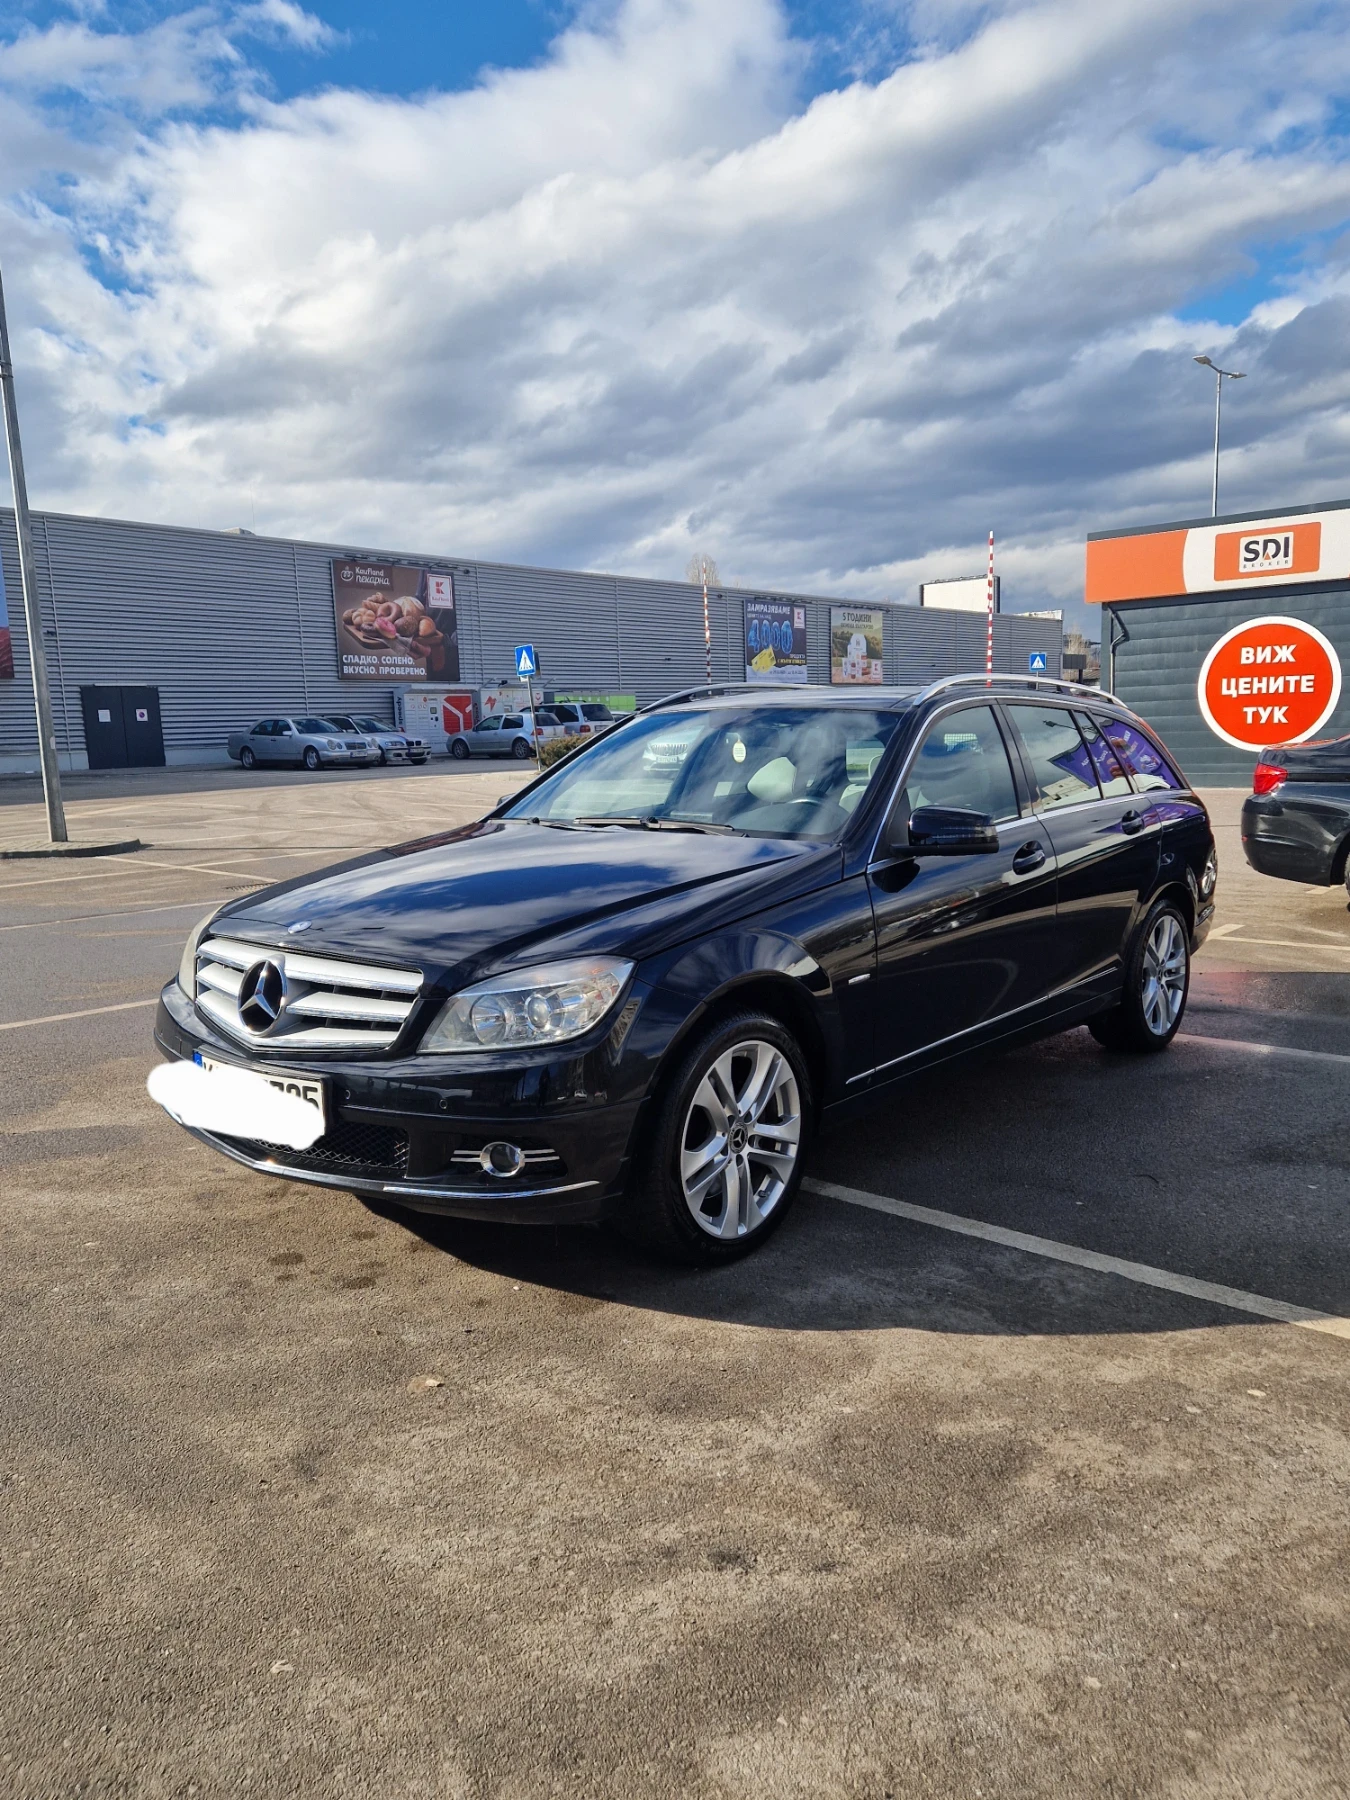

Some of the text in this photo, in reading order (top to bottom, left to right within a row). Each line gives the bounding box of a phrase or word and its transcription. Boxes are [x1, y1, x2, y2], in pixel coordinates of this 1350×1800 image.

[1243, 536, 1290, 562] SDI
[355, 566, 384, 577] Kaufland
[842, 612, 872, 623] 5 ГОДИНИ
[748, 619, 793, 654] 4000
[342, 654, 415, 665] СЛАДКО. СОЛЕНО.
[1240, 644, 1298, 665] ВИЖ
[343, 665, 427, 676] ВКУСНО. ПРОВЕРЕНО.
[1221, 674, 1315, 698] ЦЕНИТЕ
[396, 696, 404, 725] speedy
[1242, 705, 1289, 725] ТУК
